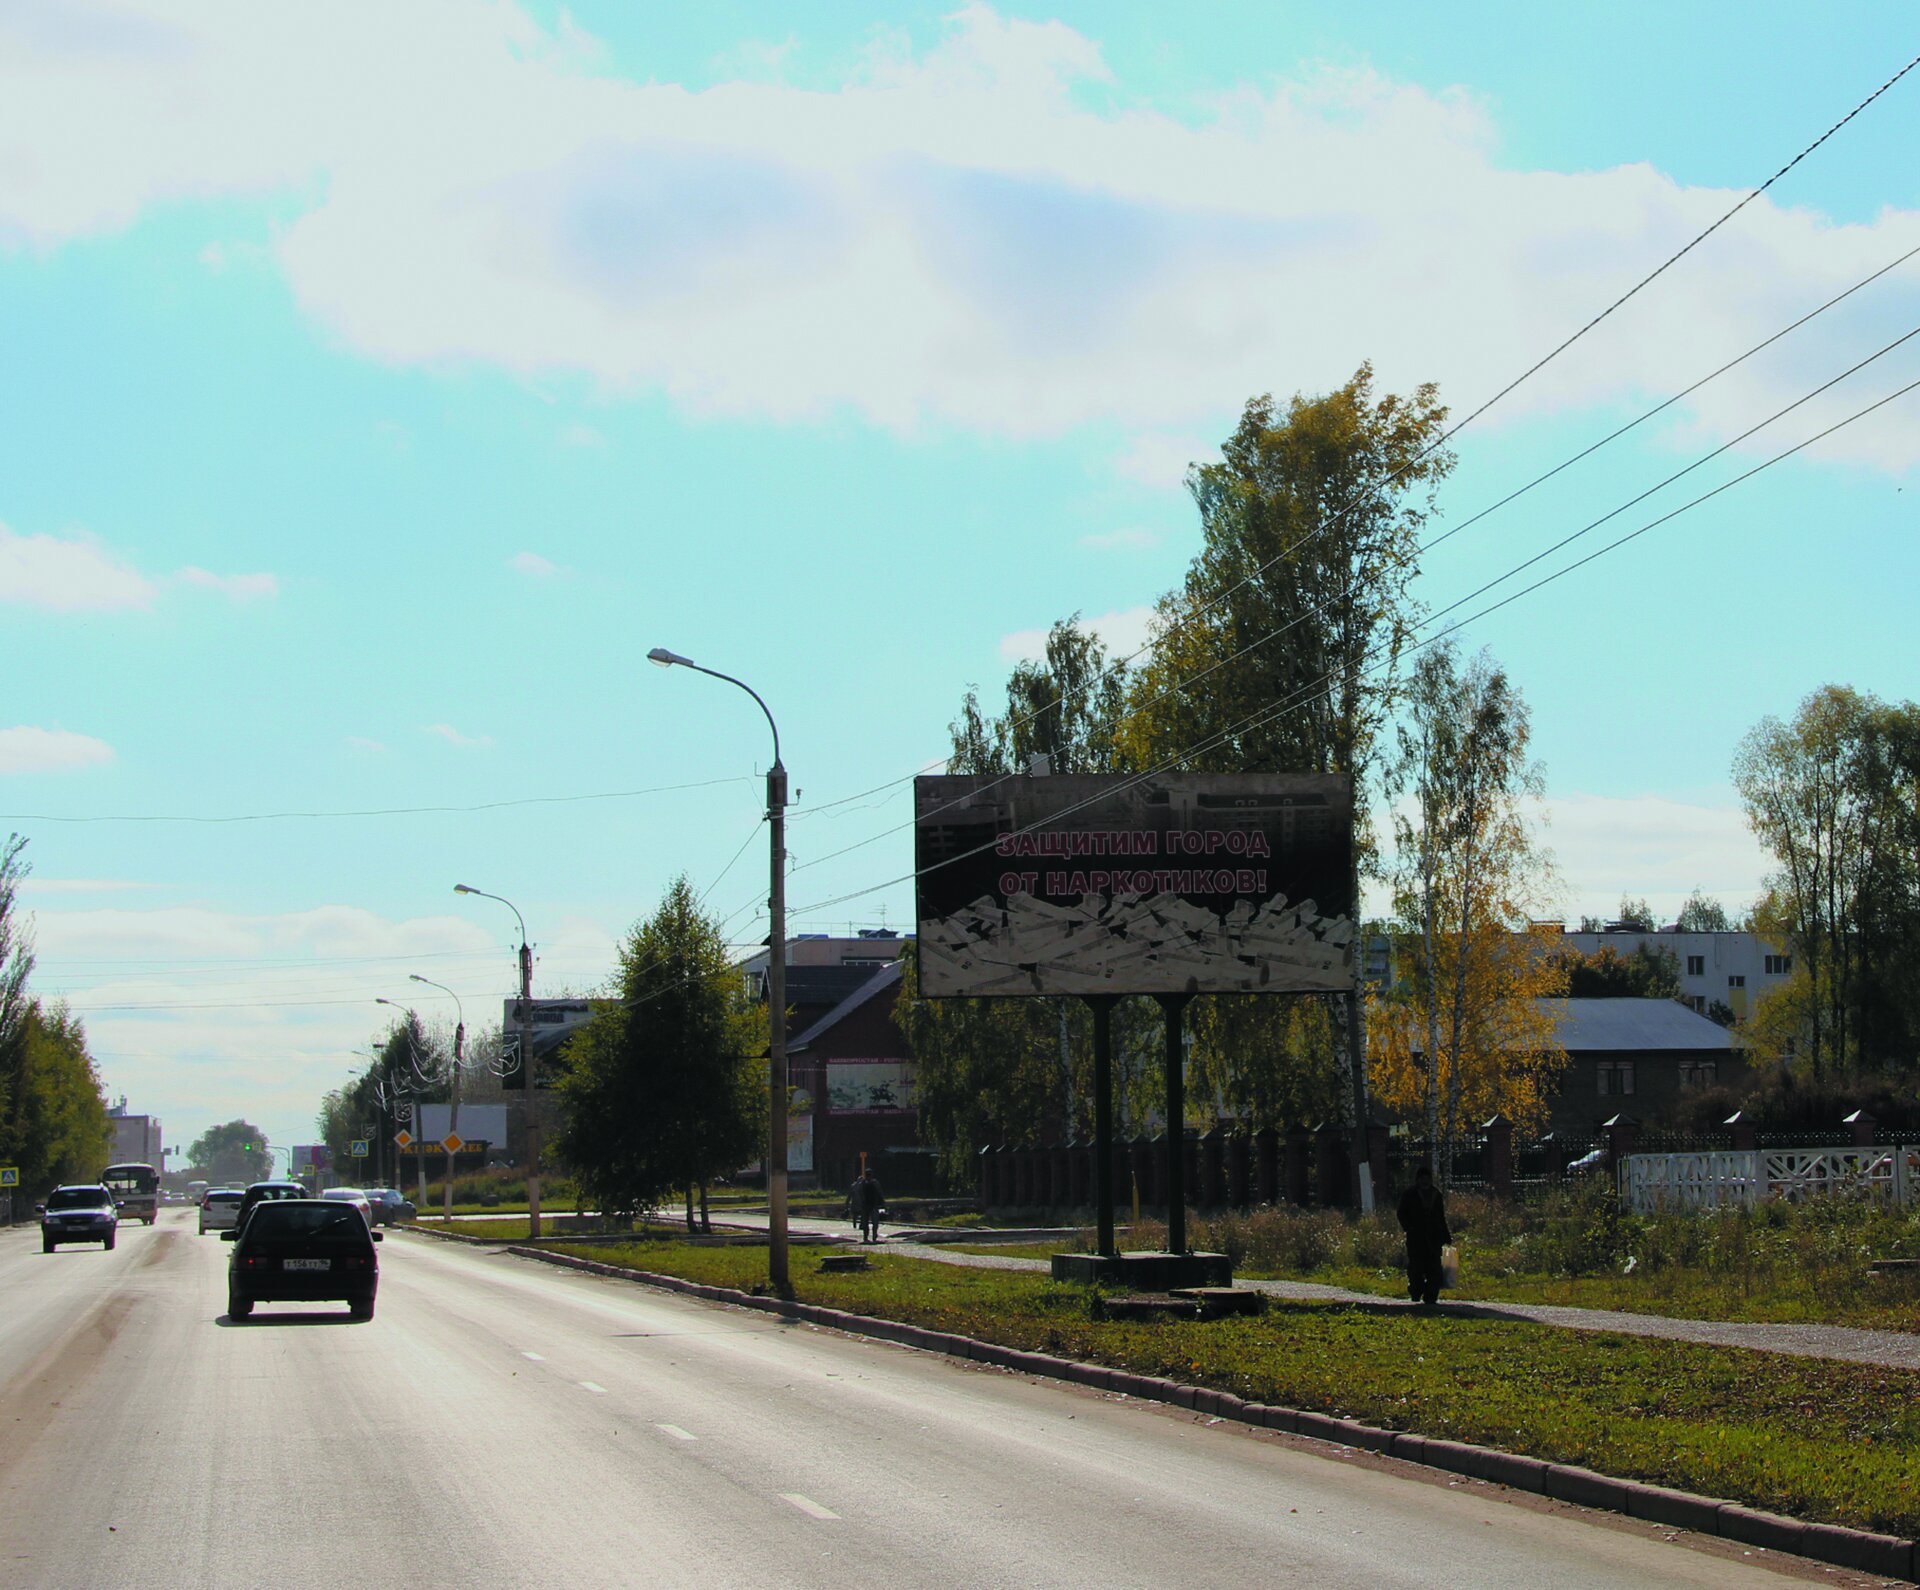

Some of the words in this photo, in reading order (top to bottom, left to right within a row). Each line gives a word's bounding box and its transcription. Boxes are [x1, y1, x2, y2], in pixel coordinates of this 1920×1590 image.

[995, 831, 1157, 860] ЗАЩИТИМ
[1166, 830, 1271, 858] ГОРОД
[999, 871, 1038, 896] ОТ
[1045, 869, 1267, 895] НАРКОТИКОВ!
